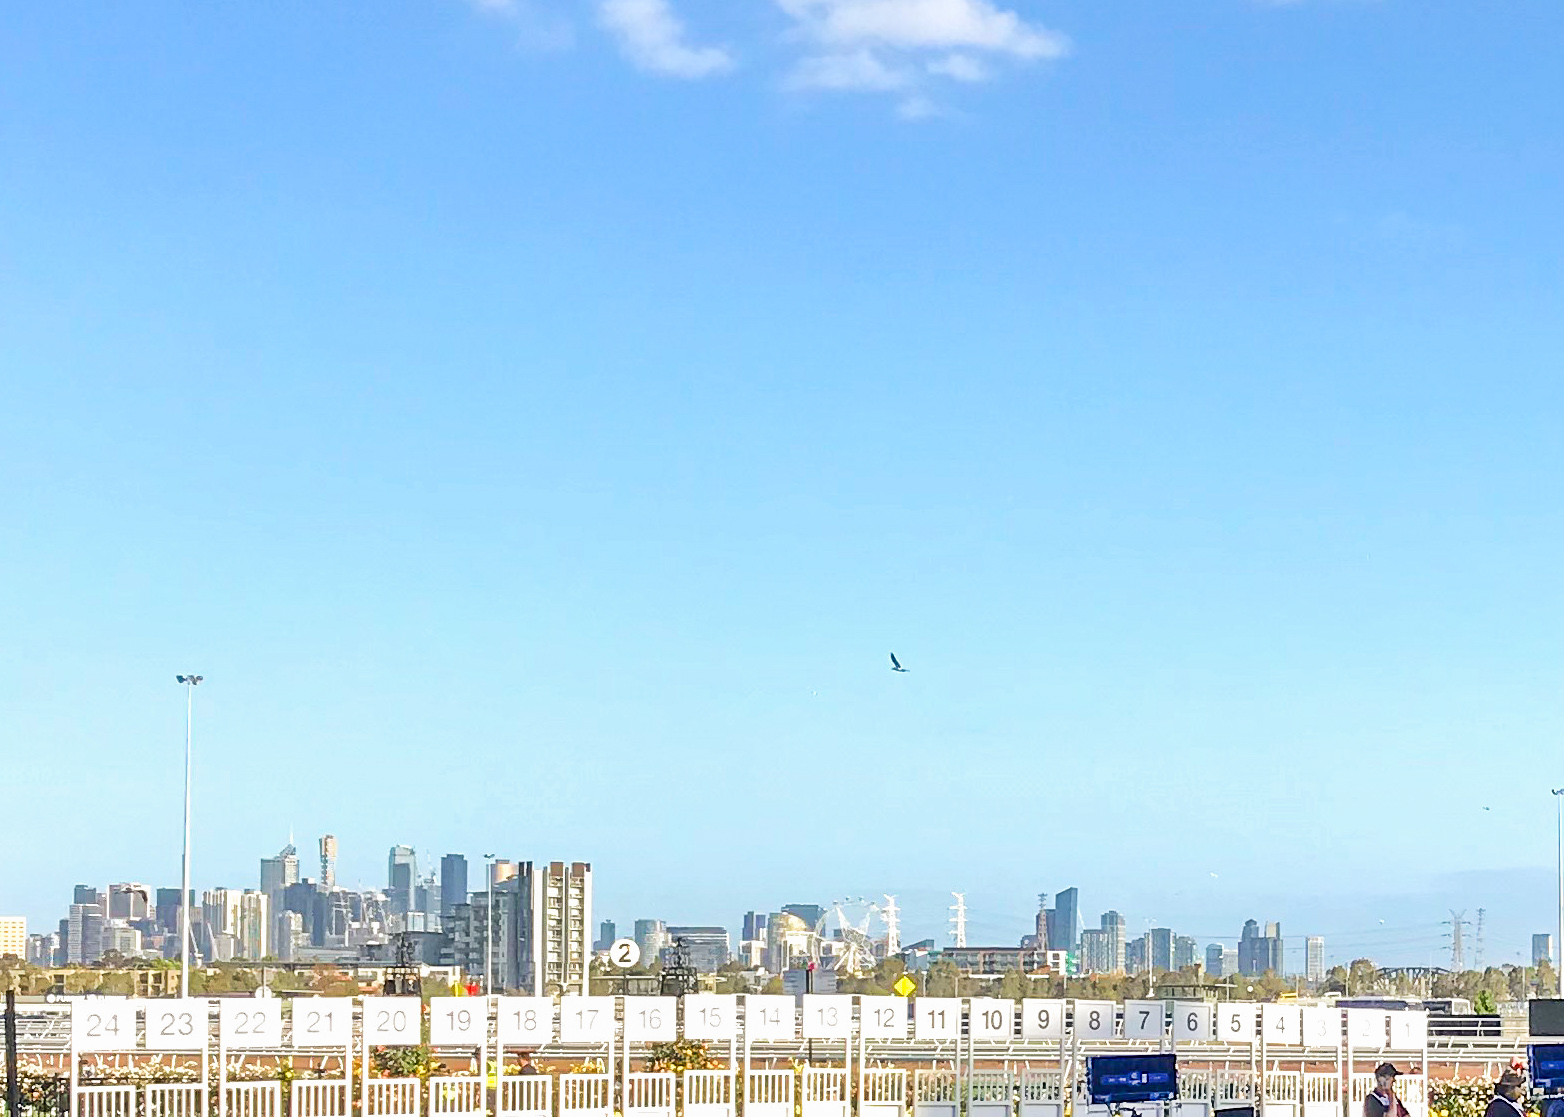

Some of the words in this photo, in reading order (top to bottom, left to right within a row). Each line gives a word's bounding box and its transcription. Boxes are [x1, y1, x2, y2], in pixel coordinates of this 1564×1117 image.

[618, 943, 633, 963] 2
[86, 1013, 120, 1037] 24
[160, 1012, 194, 1036] 23
[234, 1011, 267, 1035] 22
[306, 1011, 334, 1032] 21
[376, 1010, 407, 1032] 20
[446, 1009, 471, 1031] 19
[513, 1009, 537, 1031] 18
[575, 1009, 599, 1030] 17
[639, 1008, 662, 1030] 16
[699, 1007, 721, 1028] 15
[759, 1007, 781, 1027] 14
[817, 1007, 839, 1027] 13
[873, 1008, 895, 1028] 12
[927, 1009, 946, 1029] 11
[981, 1009, 1002, 1030] 10
[1037, 1009, 1050, 1030] 9
[1088, 1010, 1101, 1031] 8
[1138, 1010, 1151, 1030] 7
[1186, 1012, 1198, 1032] 6
[1230, 1013, 1242, 1033] 5
[1275, 1015, 1286, 1033] 4
[1317, 1018, 1327, 1037] 3
